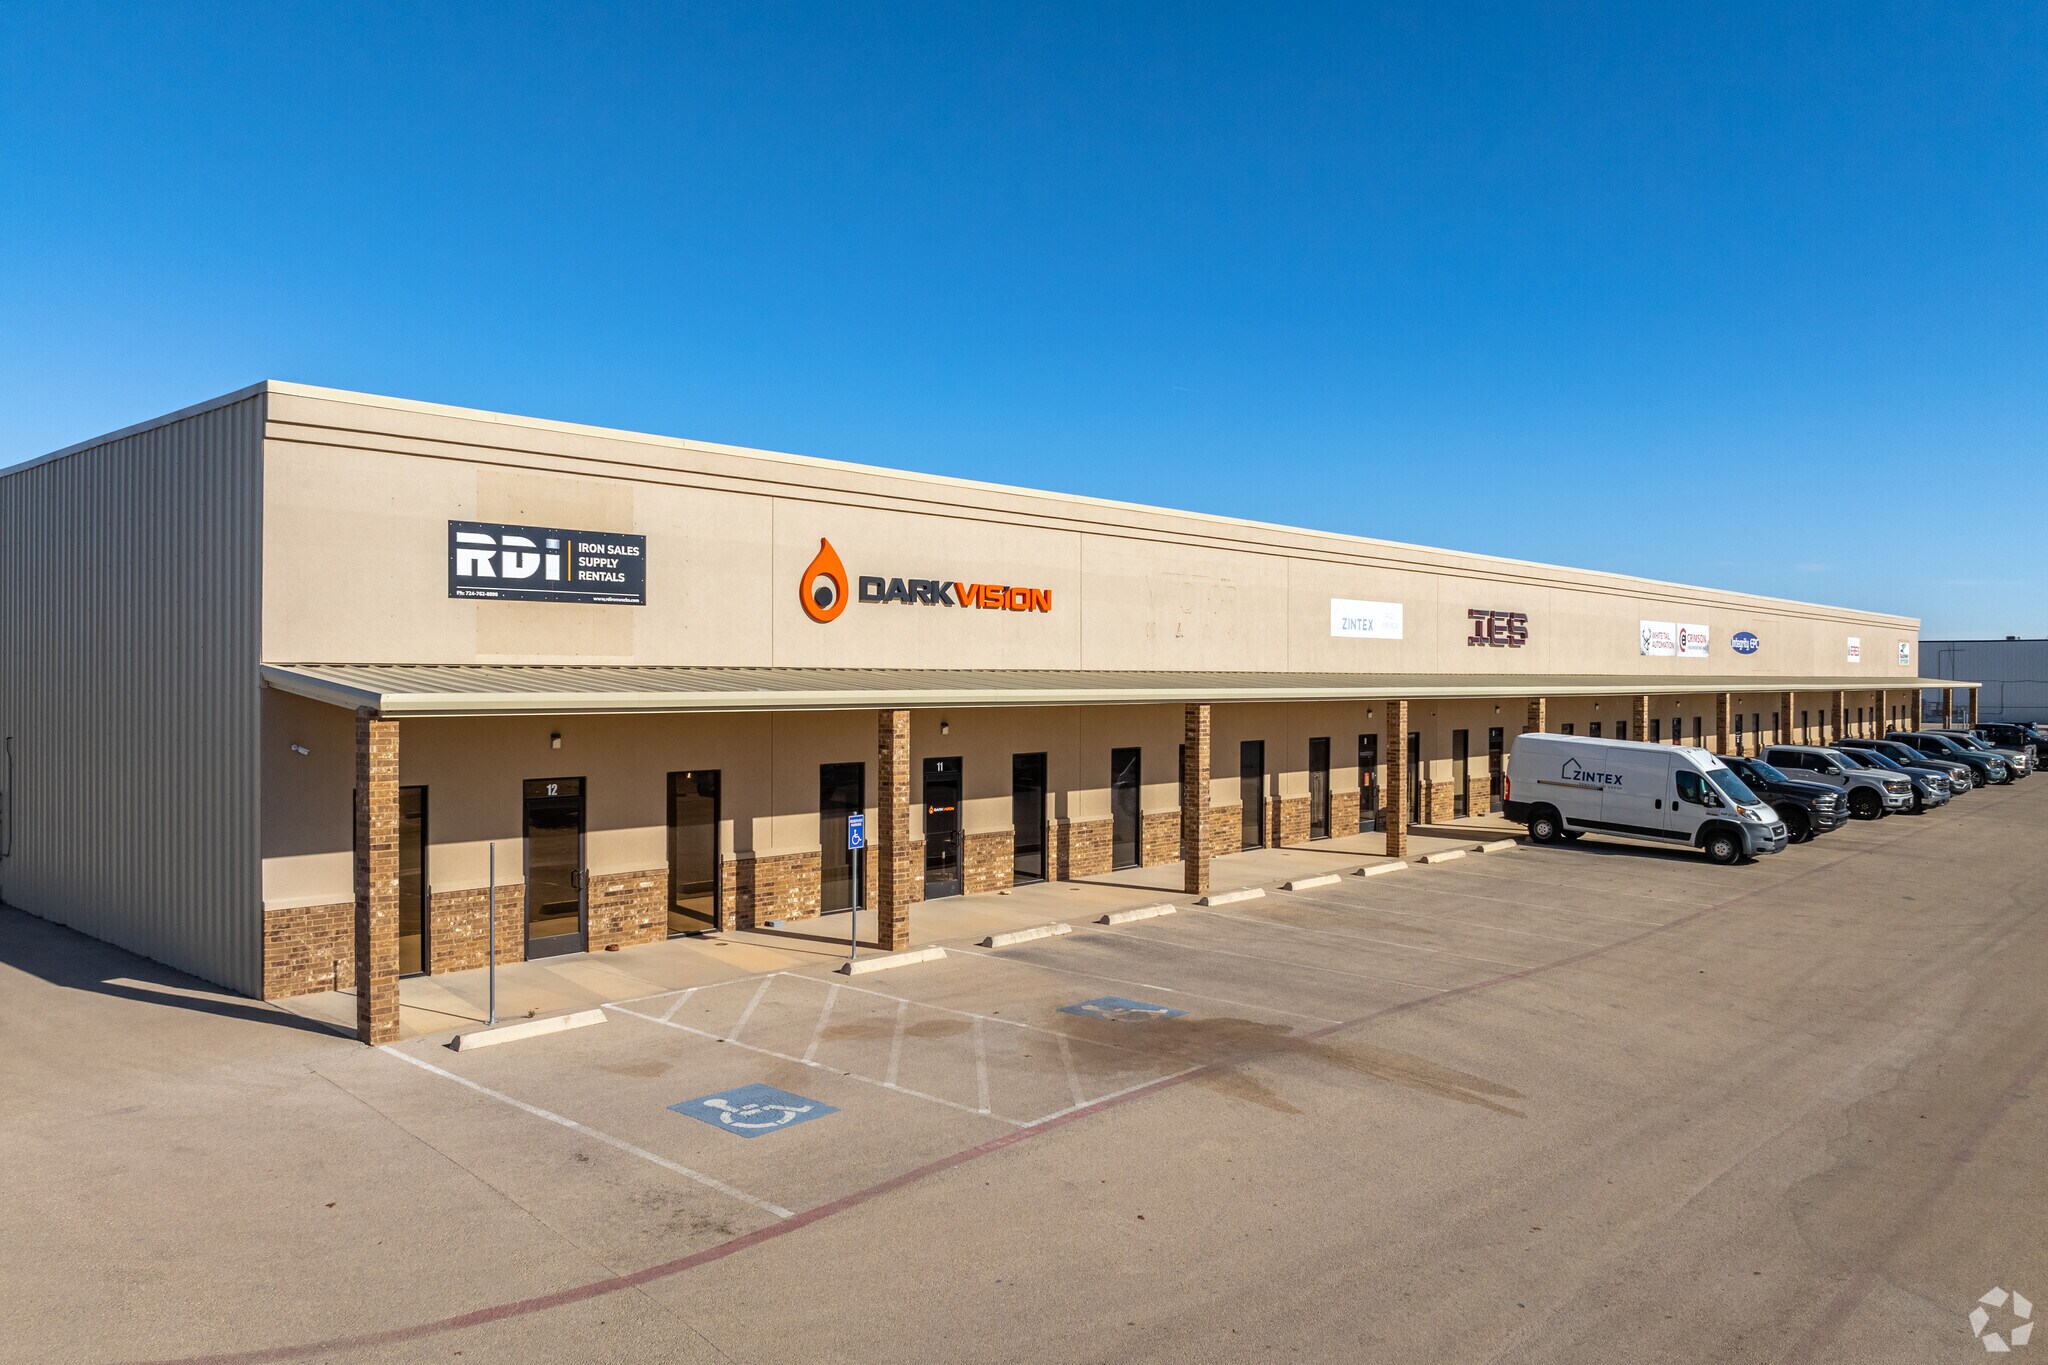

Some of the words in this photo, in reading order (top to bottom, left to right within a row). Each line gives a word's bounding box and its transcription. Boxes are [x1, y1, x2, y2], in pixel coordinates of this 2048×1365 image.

[578, 542, 605, 554] IRON
[607, 544, 640, 557] SALES
[578, 556, 619, 568] SUPPLY
[578, 570, 626, 583] RENTALS
[858, 575, 1052, 612] DARKVISION
[1342, 617, 1374, 631] ZINTEX
[1687, 633, 1707, 644] CRIMSON
[936, 762, 944, 772] 11
[1573, 770, 1623, 785] ZINTEX
[546, 783, 558, 796] 12
